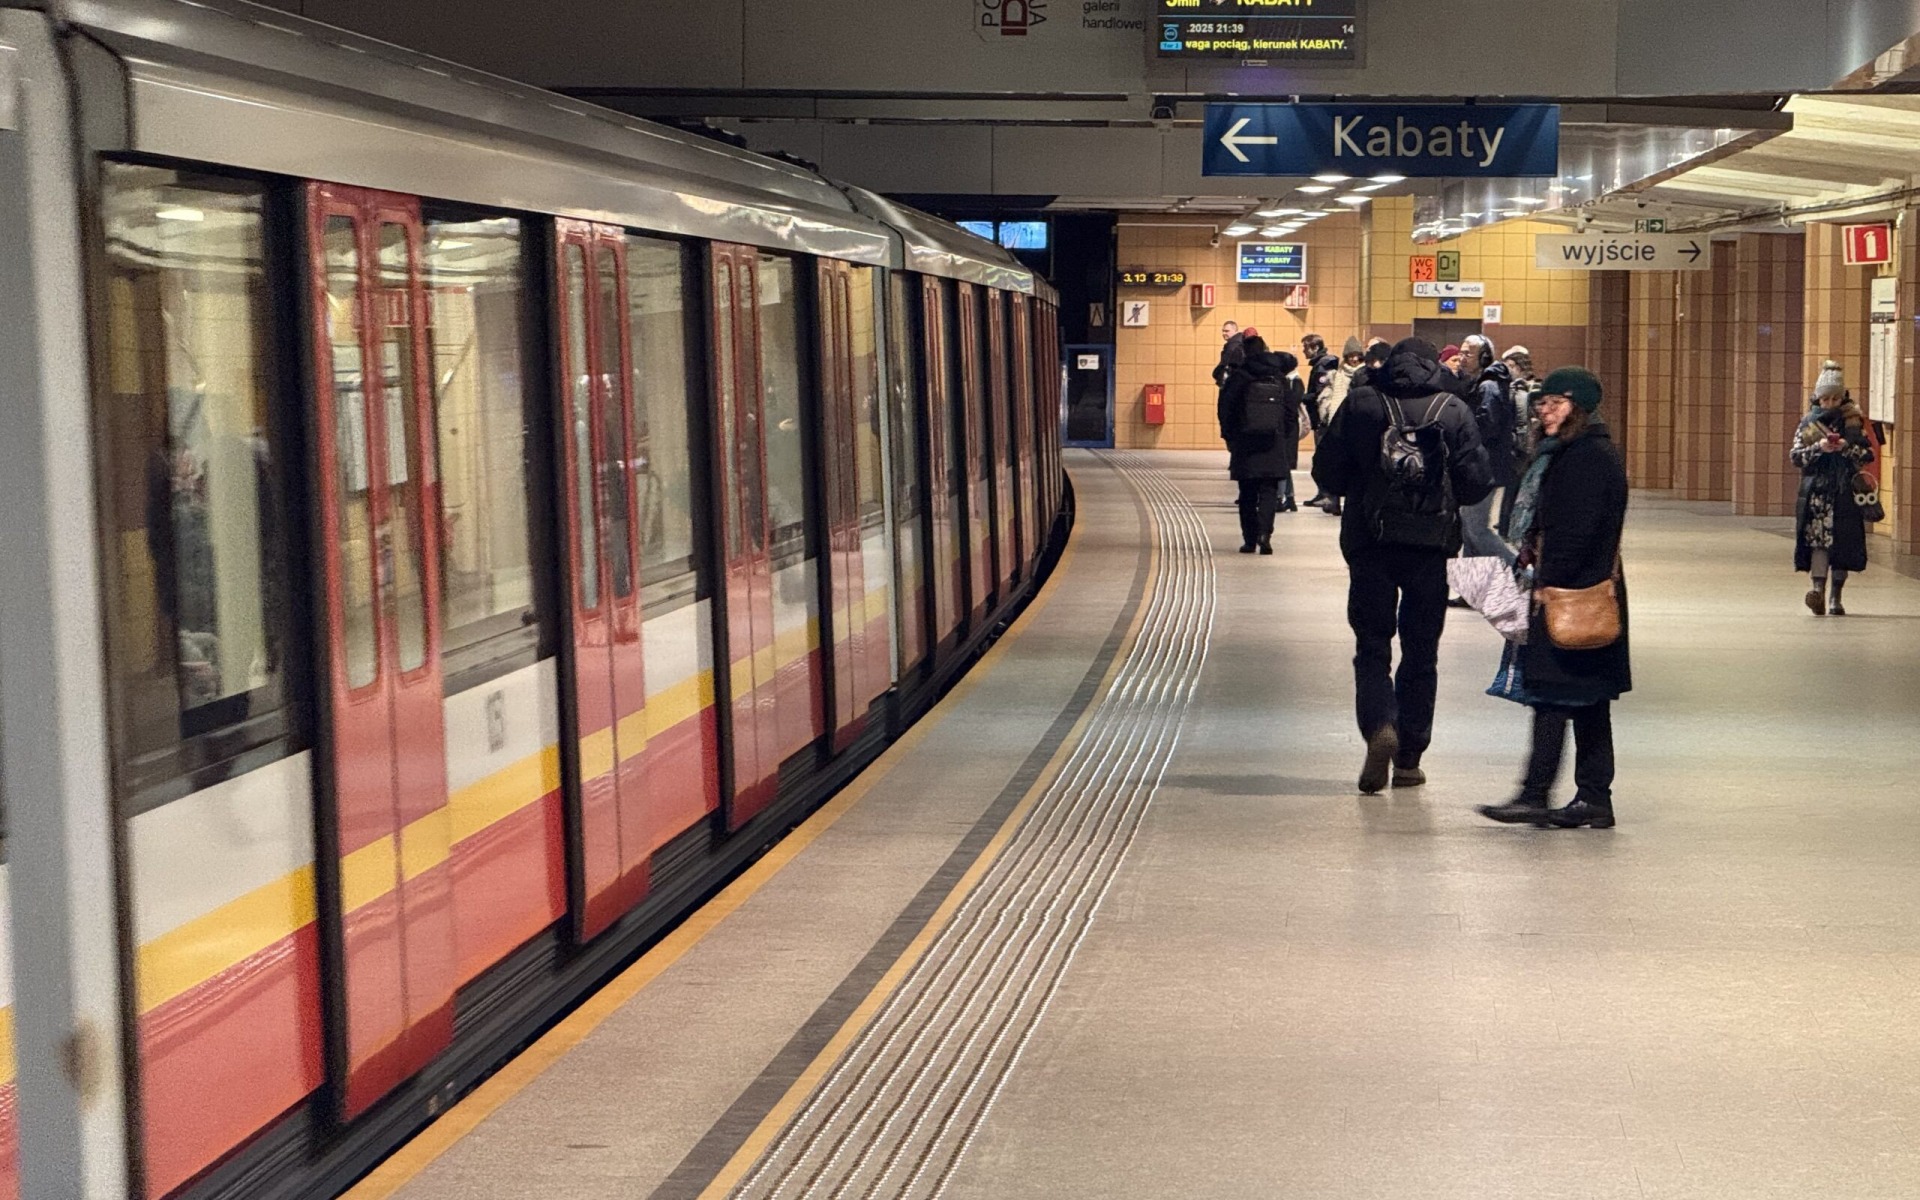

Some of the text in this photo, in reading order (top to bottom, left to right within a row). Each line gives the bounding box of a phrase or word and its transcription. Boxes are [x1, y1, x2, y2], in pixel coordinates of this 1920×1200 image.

[1187, 24, 1214, 34] .2025
[1216, 24, 1244, 33] 21:39
[1342, 25, 1354, 34] 14
[1253, 39, 1298, 49] kierunek
[1334, 116, 1505, 167] Kabaty
[1562, 239, 1656, 266] wyjście
[1414, 258, 1433, 268] WC
[1154, 273, 1184, 283] 21:39
[1421, 267, 1433, 280] -2
[1460, 285, 1481, 293] winda
